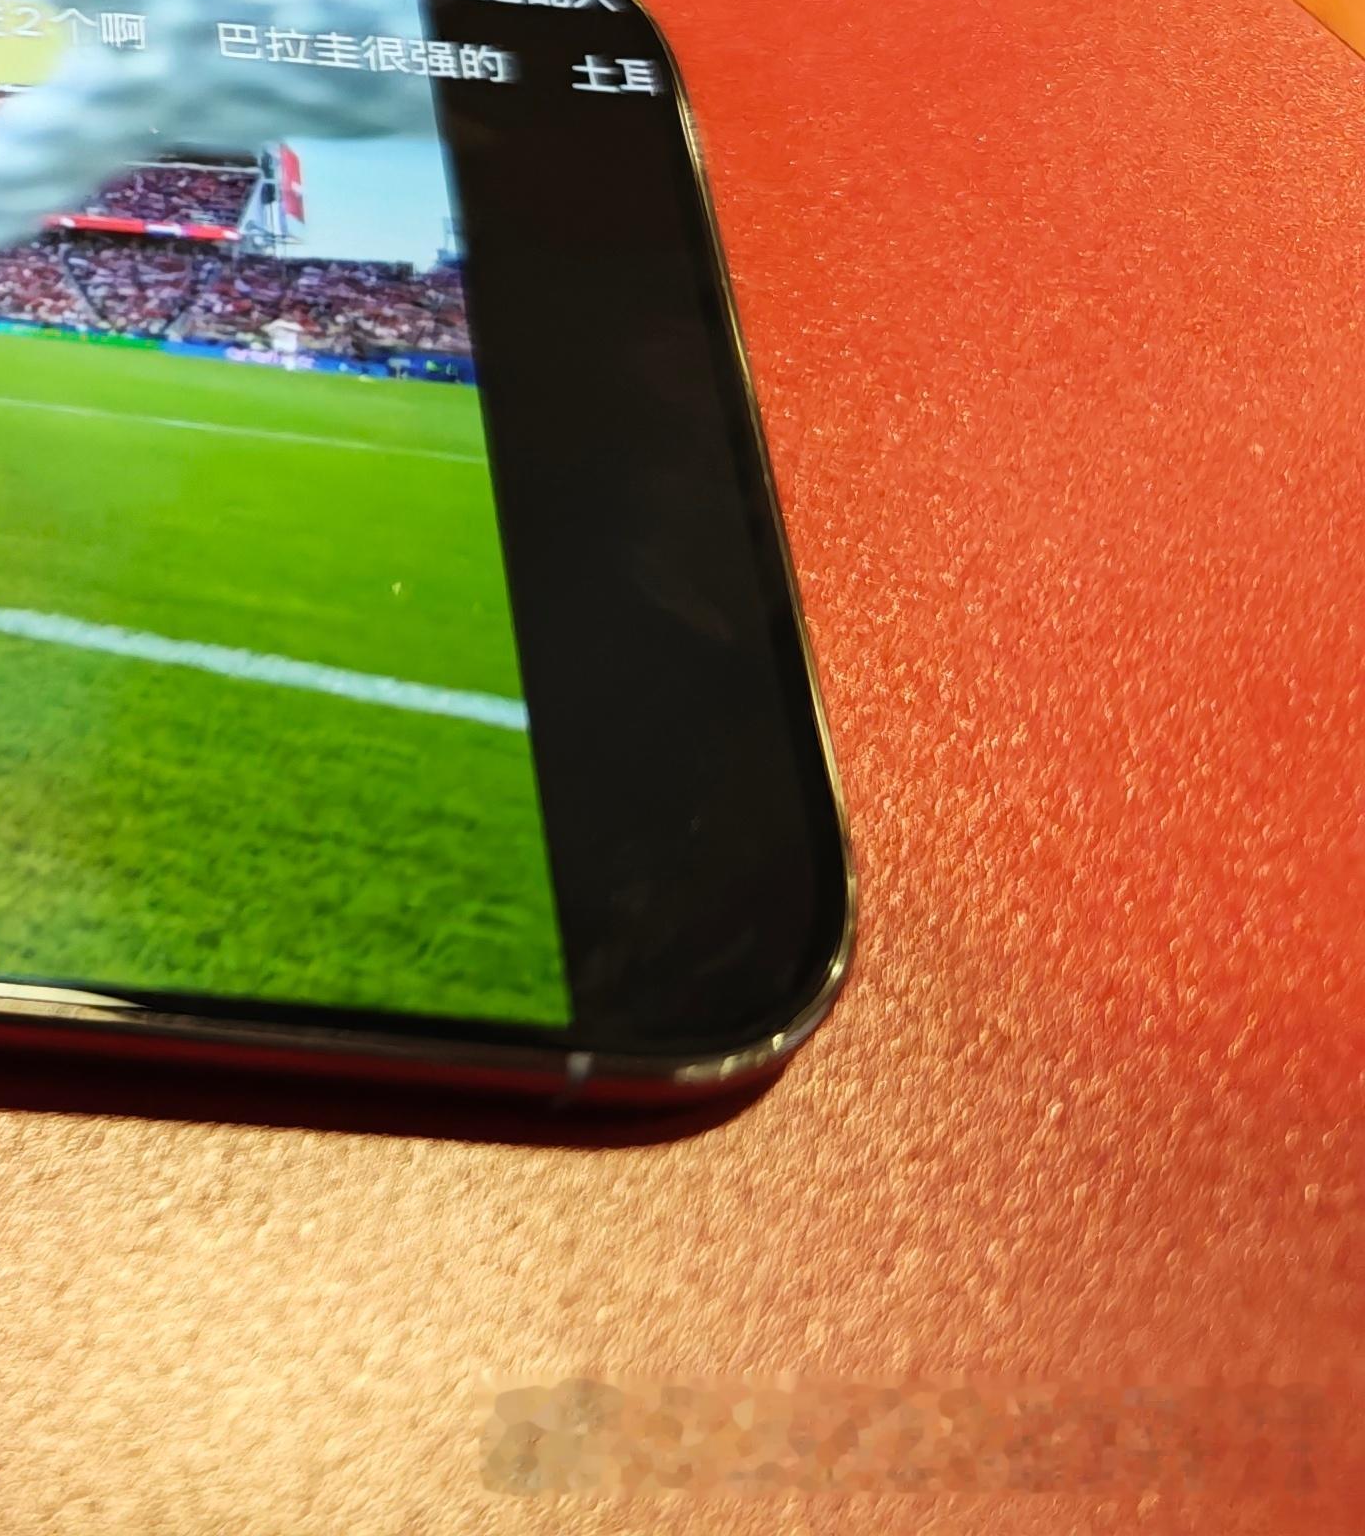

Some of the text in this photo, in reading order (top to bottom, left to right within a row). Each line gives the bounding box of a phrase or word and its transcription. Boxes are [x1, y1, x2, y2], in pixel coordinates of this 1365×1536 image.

[217, 22, 511, 83] 巴拉圭很强的
